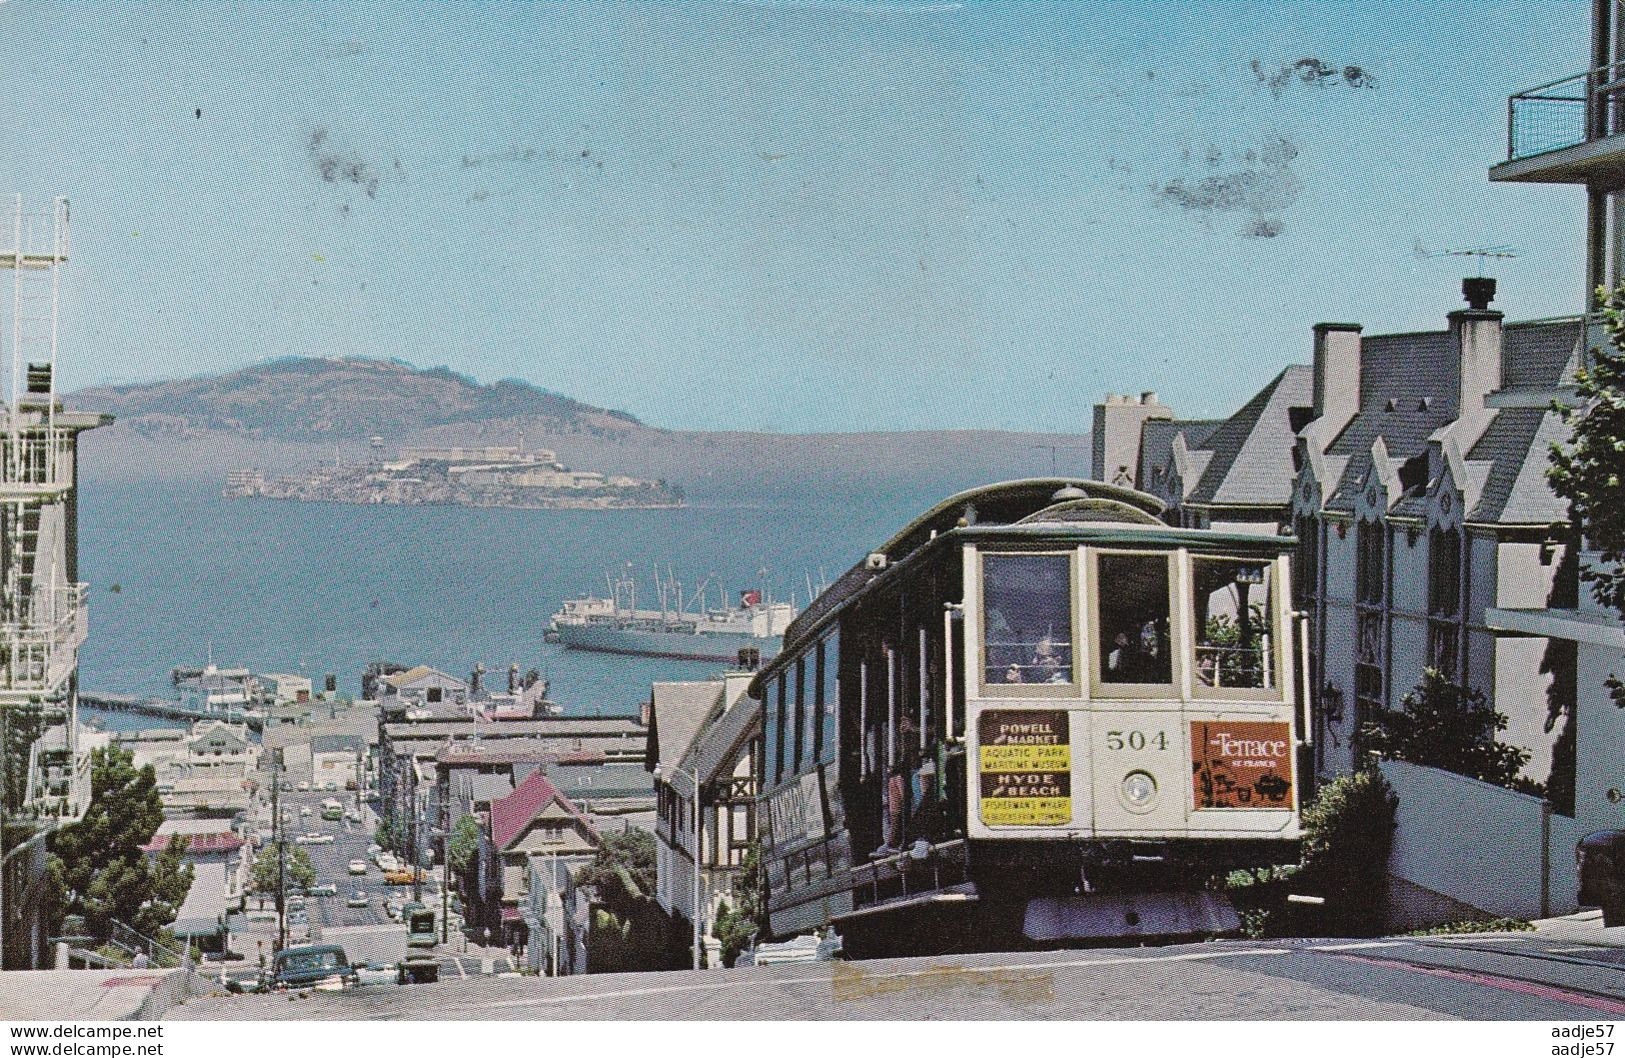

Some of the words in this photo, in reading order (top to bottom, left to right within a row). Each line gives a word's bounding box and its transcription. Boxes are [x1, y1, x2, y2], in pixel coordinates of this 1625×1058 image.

[1000, 723, 1053, 734] POWELL
[1007, 735, 1058, 744] MARKET
[1107, 730, 1169, 751] 504
[1216, 733, 1286, 757] Terrace
[985, 748, 1029, 758] AQUATIC
[1038, 748, 1065, 757] PARK
[999, 774, 1054, 784] HYDE
[1008, 786, 1060, 795] BEACH
